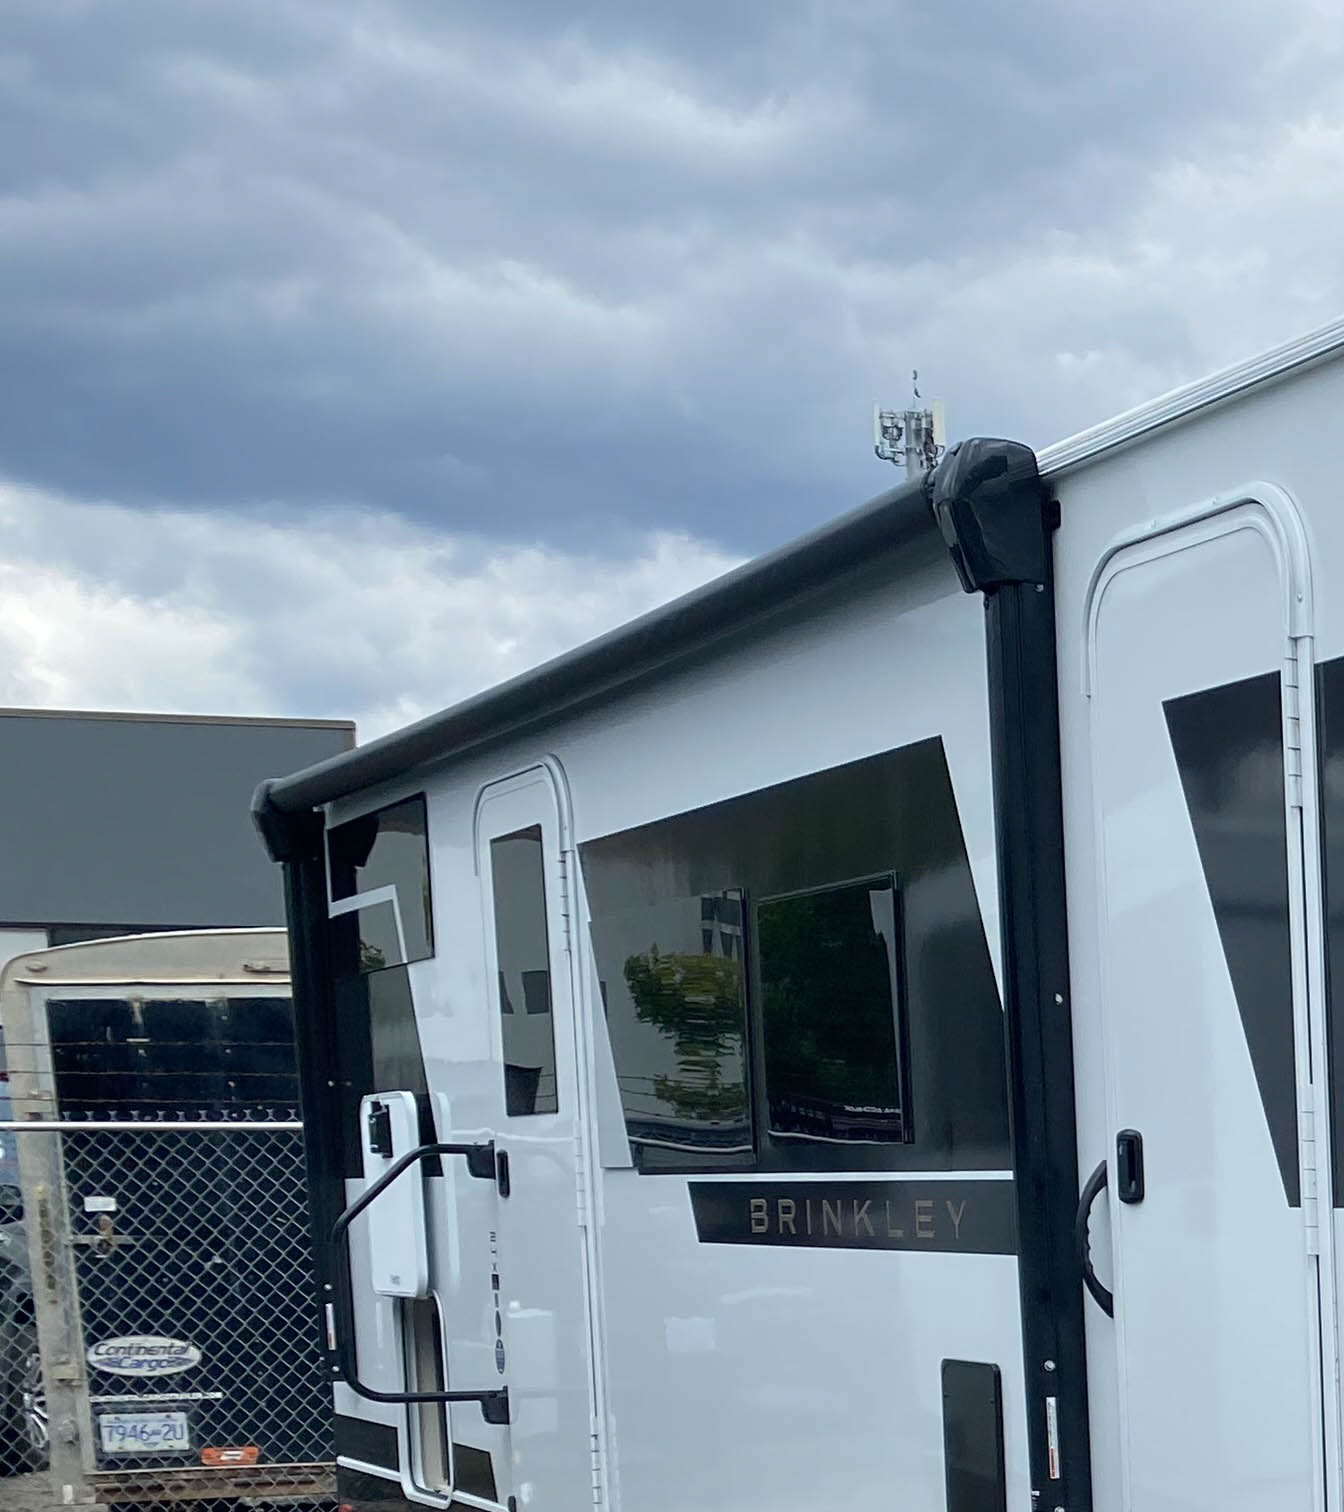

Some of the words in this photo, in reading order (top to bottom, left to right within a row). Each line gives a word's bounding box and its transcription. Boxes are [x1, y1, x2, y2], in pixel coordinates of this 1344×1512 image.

[750, 1198, 968, 1240] BRINKLEY
[94, 1342, 190, 1356] Continental
[119, 1357, 169, 1371] Cargo
